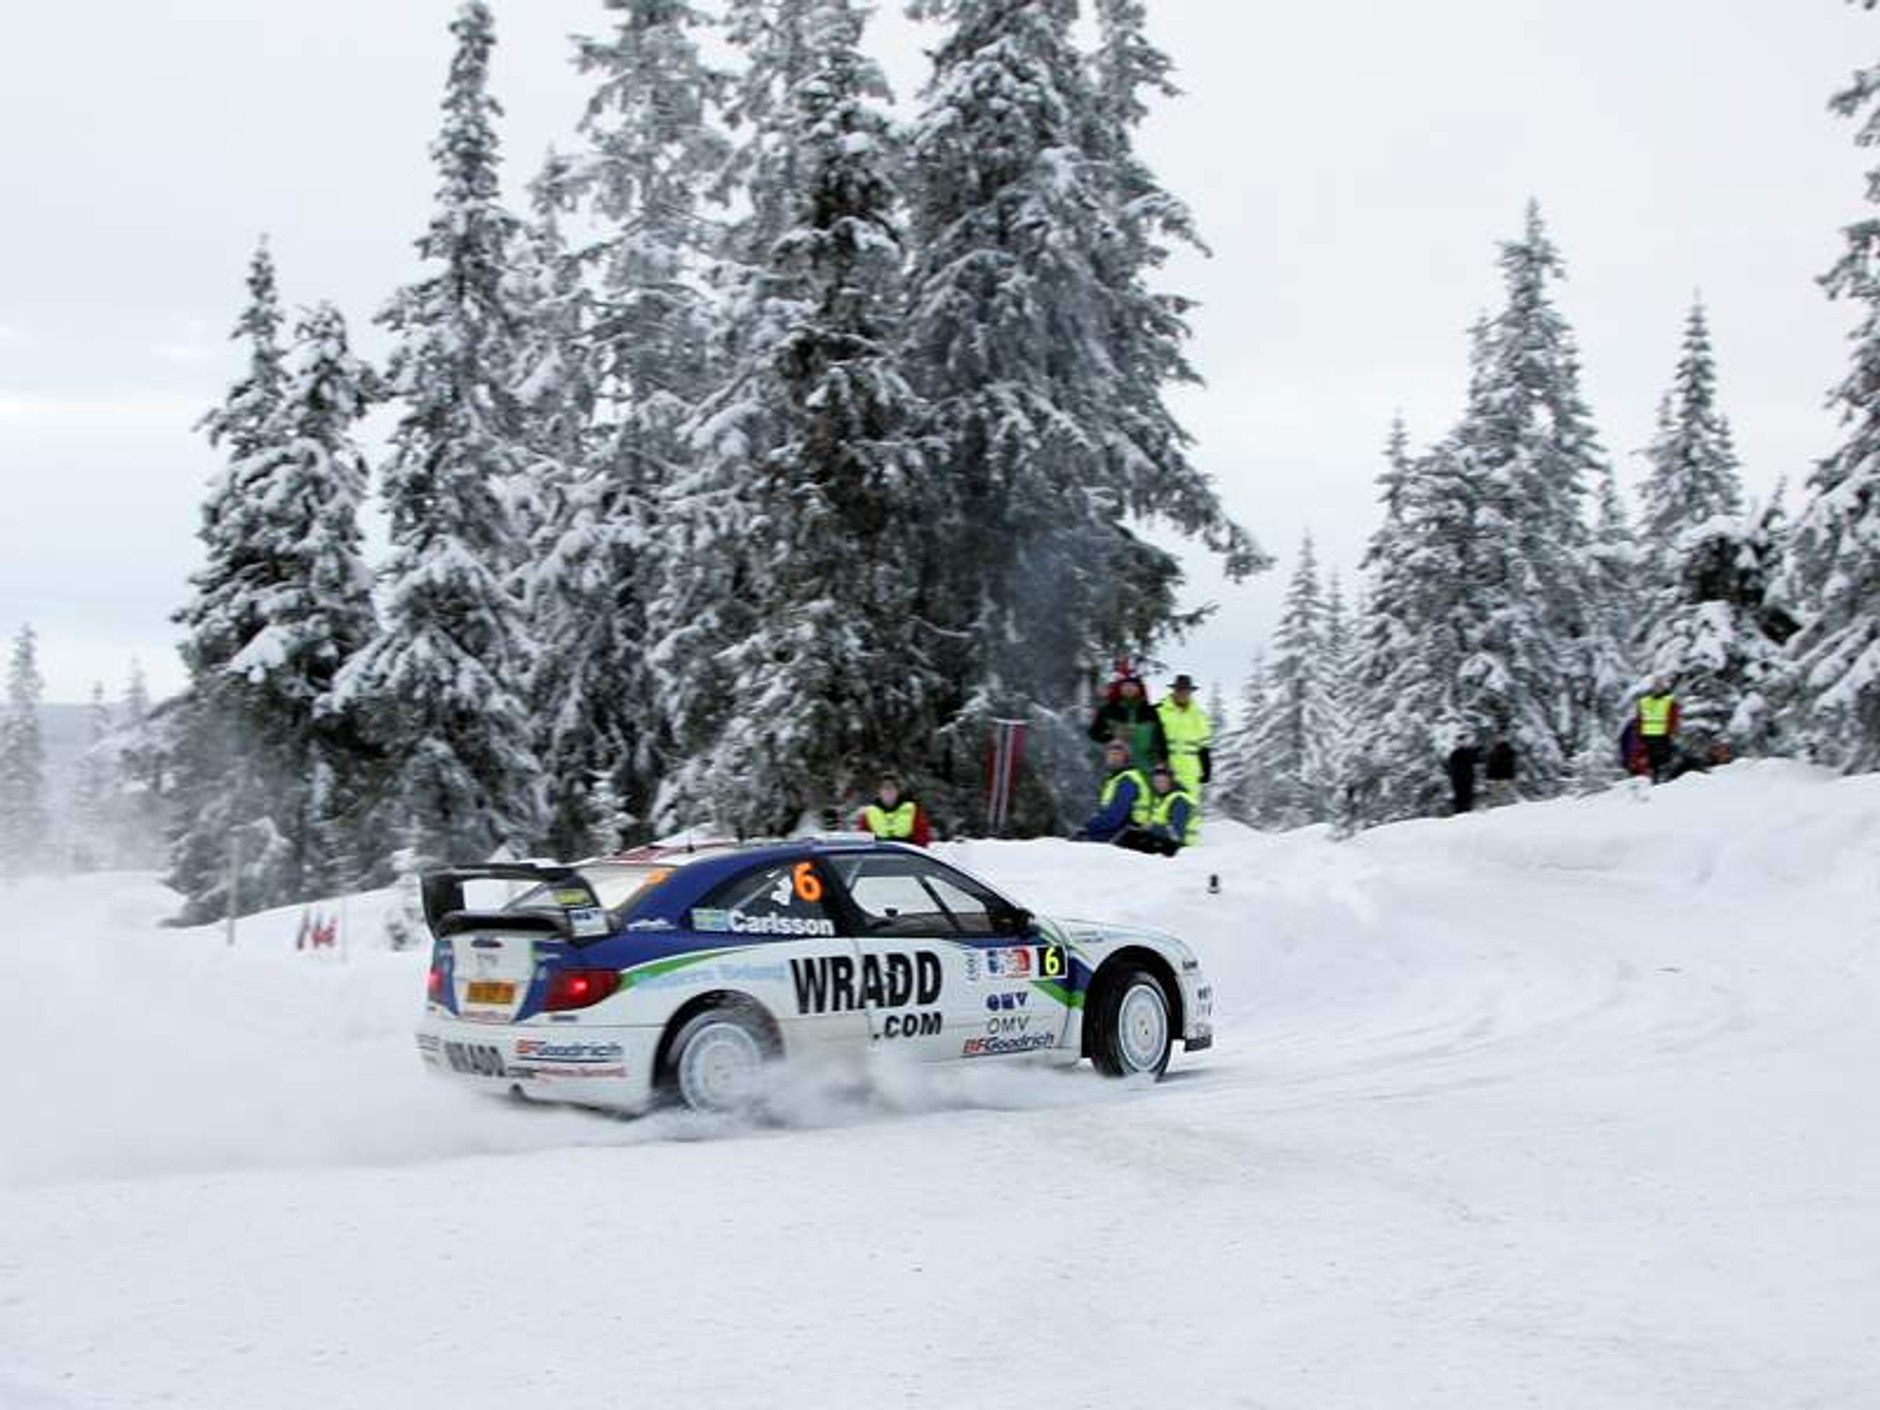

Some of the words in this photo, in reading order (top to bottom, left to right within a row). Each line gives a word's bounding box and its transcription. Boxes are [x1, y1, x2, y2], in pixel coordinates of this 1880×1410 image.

[793, 861, 823, 903] 6
[729, 908, 836, 936] Carlsson
[1045, 946, 1060, 975] 6
[789, 951, 942, 1015] WRADD
[873, 1011, 942, 1040] .COM
[986, 1015, 1031, 1035] OMV
[963, 1032, 1056, 1056] BFGoodrich
